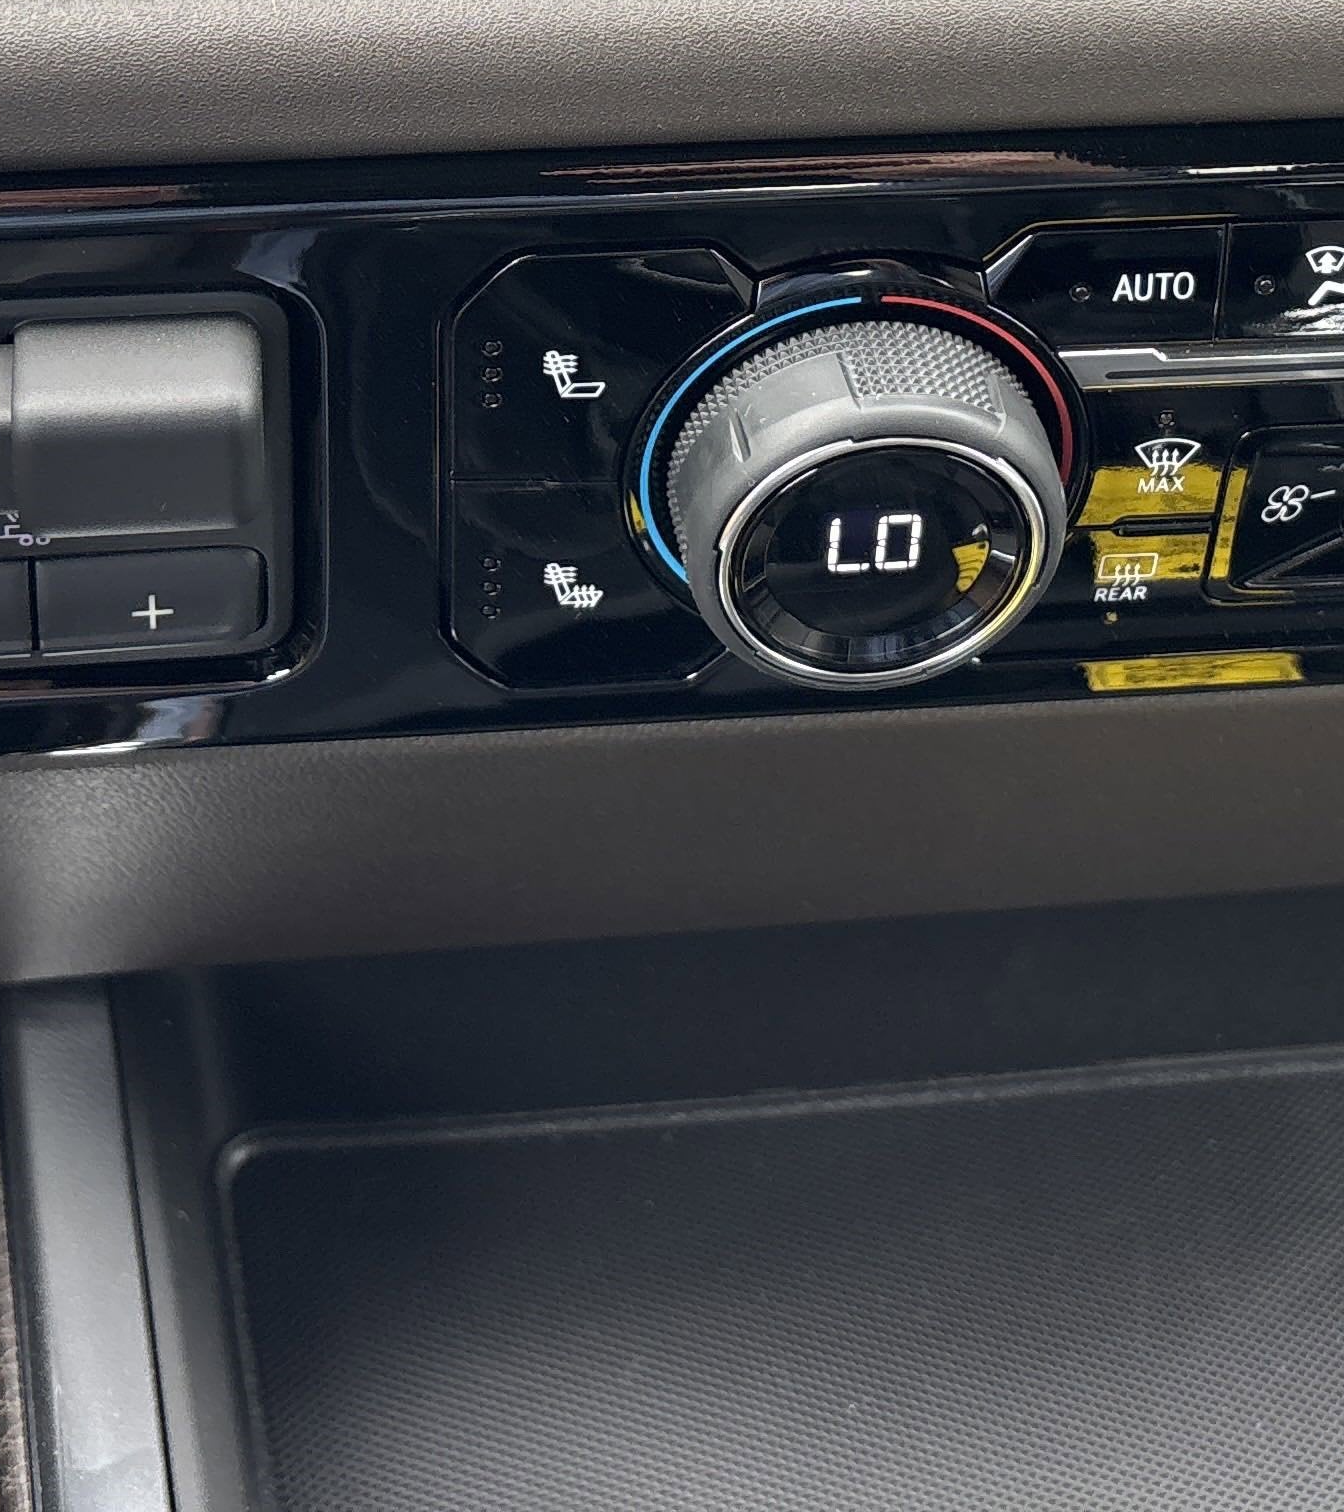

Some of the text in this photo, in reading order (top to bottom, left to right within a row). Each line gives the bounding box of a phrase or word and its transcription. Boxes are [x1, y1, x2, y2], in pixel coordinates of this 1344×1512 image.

[1111, 271, 1196, 303] AUTO
[1137, 476, 1186, 494] MAX
[1093, 585, 1149, 603] REAR
